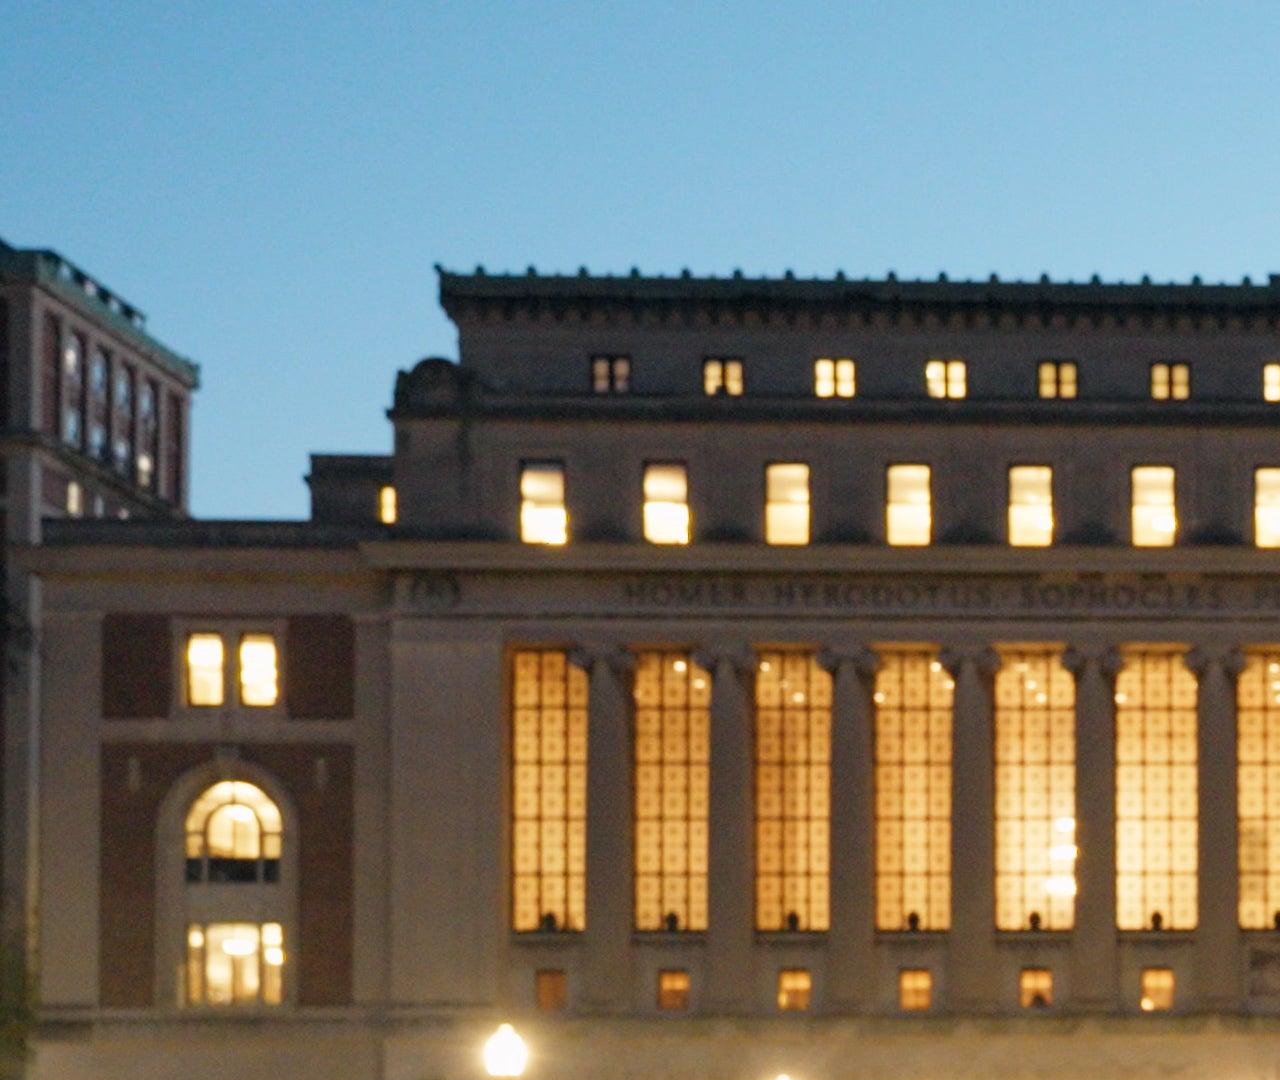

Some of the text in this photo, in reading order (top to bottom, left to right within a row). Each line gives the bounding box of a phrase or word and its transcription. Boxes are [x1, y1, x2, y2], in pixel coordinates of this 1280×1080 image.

[624, 584, 747, 608] HOMER
[774, 584, 991, 608] HERODOTUS
[1020, 585, 1225, 610] SOPHOCLES
